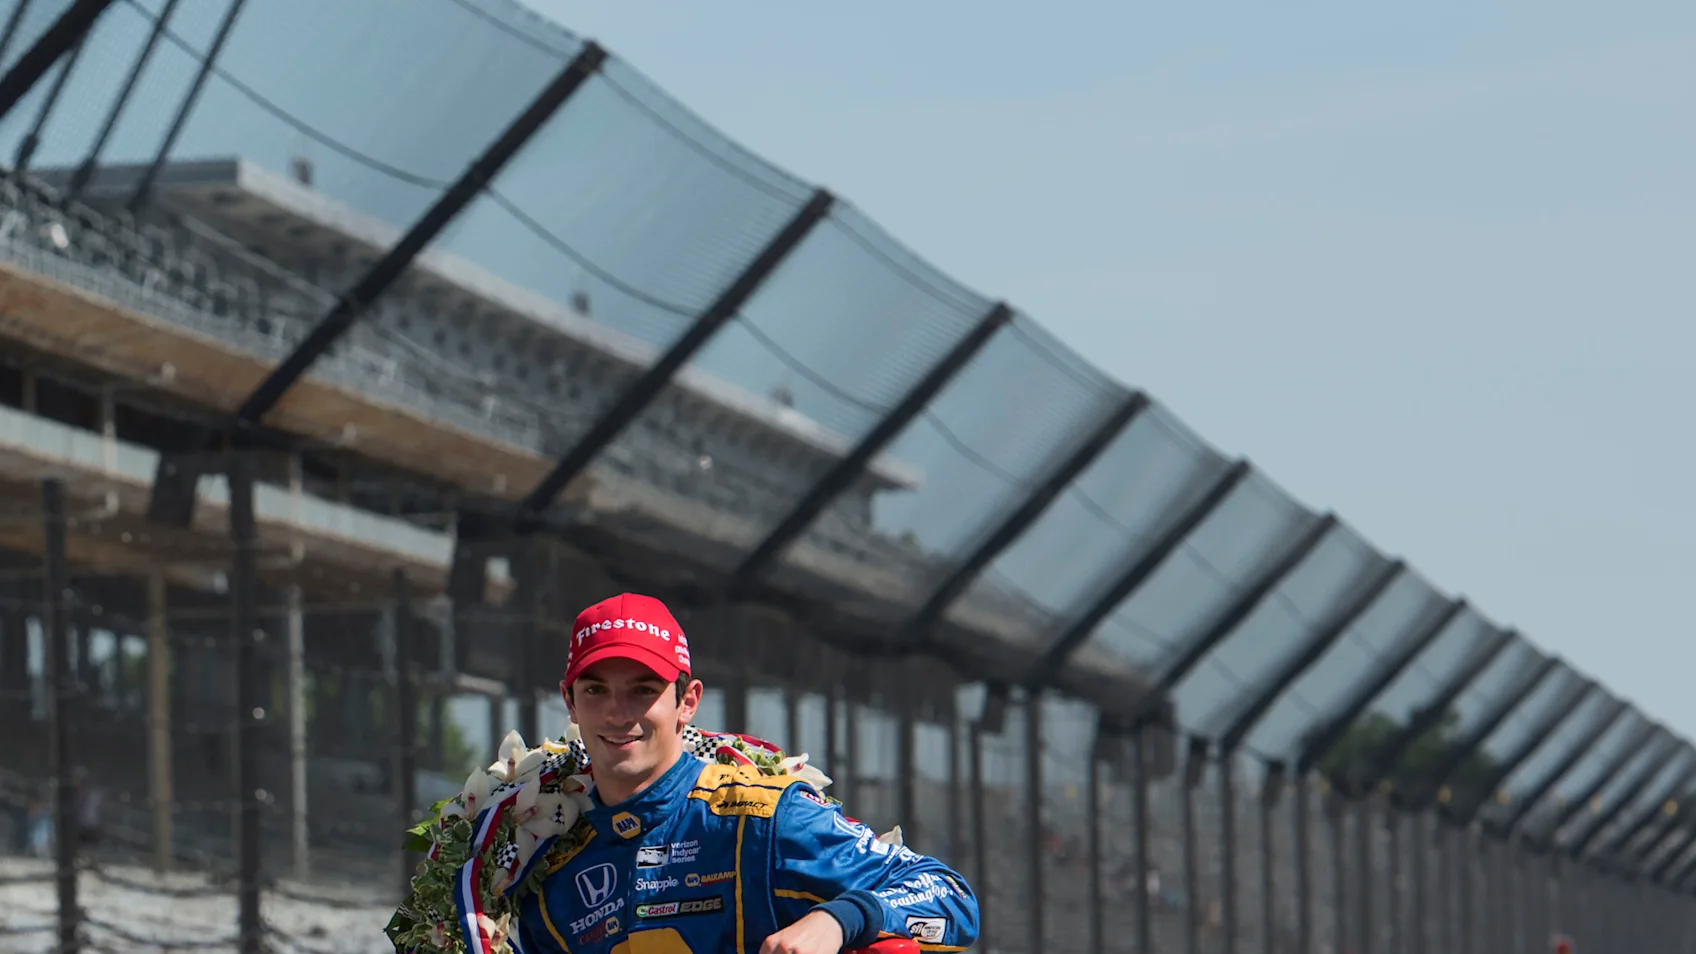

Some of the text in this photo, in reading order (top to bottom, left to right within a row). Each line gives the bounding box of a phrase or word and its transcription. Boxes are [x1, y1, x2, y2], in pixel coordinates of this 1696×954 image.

[576, 618, 670, 647] Firestone
[615, 817, 639, 834] NAPA
[671, 840, 698, 849] verizon
[672, 848, 700, 857] indycar
[672, 856, 695, 864] series
[635, 876, 679, 892] Snapple
[648, 899, 722, 915] Castrol EDGE
[570, 898, 624, 934] HONDA
